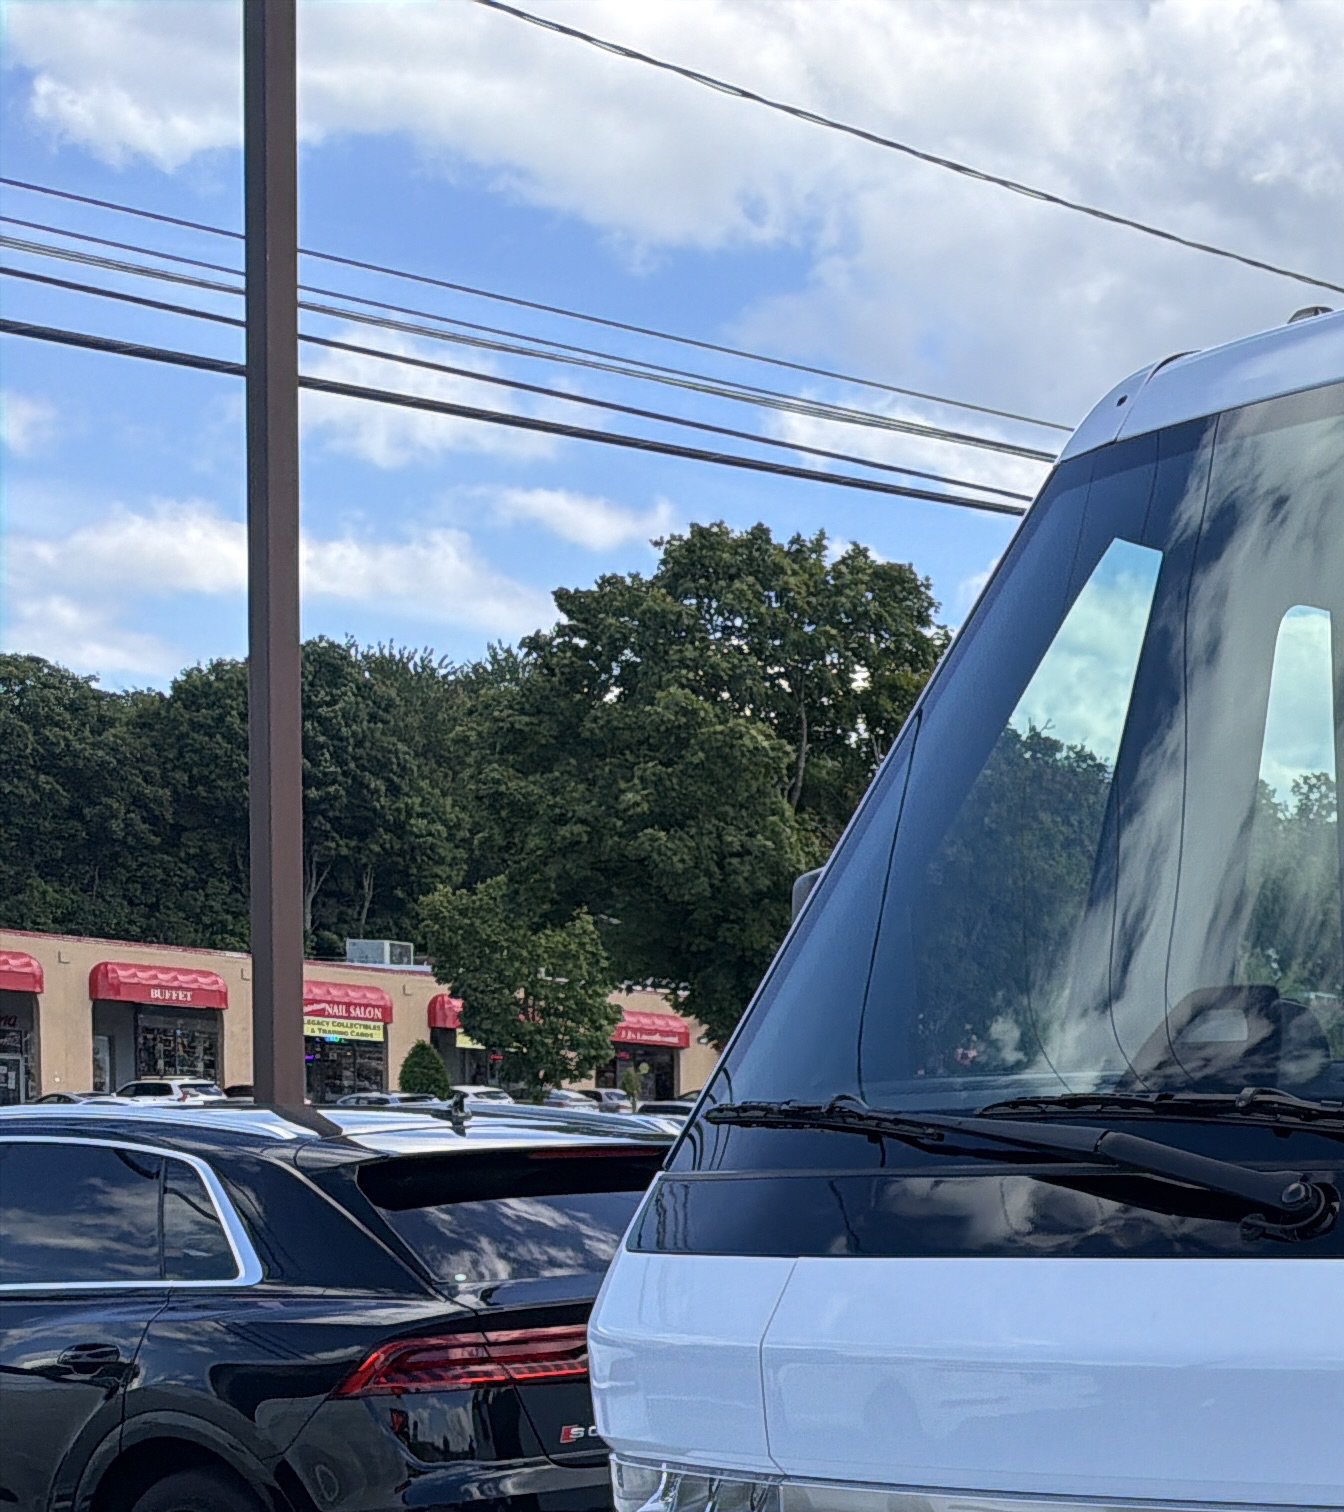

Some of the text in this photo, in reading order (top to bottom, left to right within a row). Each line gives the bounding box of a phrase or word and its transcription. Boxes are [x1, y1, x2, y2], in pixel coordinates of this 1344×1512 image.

[151, 988, 192, 1001] BUFFET
[325, 1003, 348, 1016] NAIL
[349, 1005, 382, 1019] SALON
[332, 1021, 381, 1031] COLLECTIBLES
